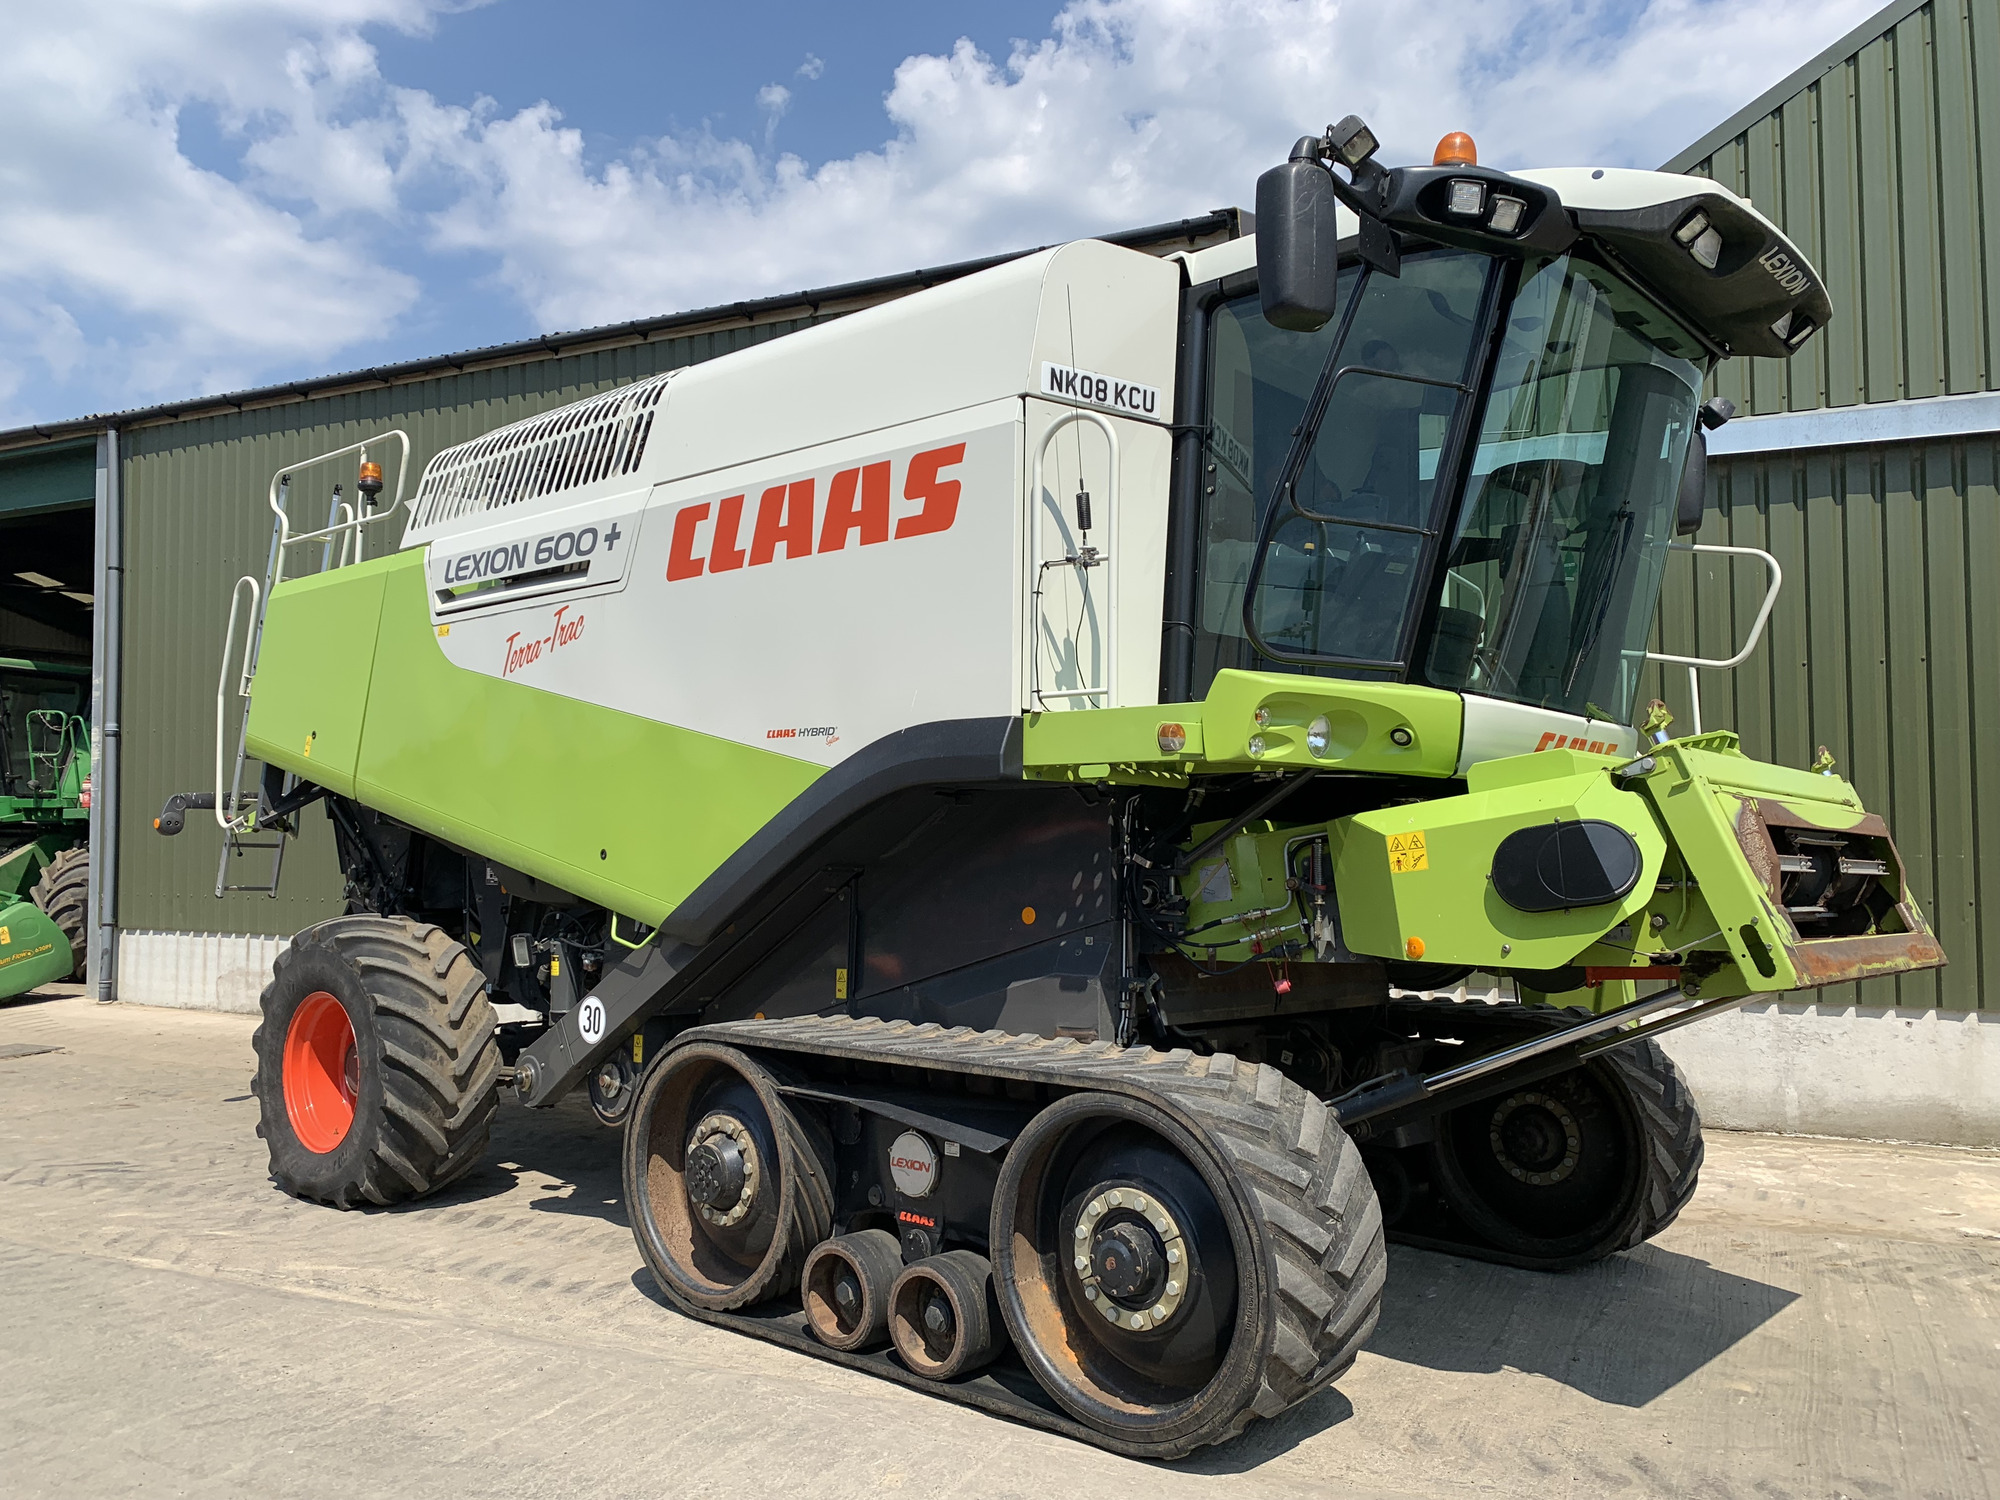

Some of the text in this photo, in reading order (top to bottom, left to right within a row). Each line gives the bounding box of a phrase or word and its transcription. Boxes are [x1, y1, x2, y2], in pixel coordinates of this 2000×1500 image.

[1758, 245, 1811, 296] LEXION
[1050, 367, 1155, 413] NK08 KCU
[666, 442, 967, 582] CLAAS
[444, 541, 529, 584] LEXION
[502, 604, 585, 678] Terra-Trac
[766, 728, 797, 739] CLAAS
[583, 1004, 601, 1035] 30
[891, 1156, 931, 1173] LEXION
[899, 1211, 935, 1227] CLAAS
